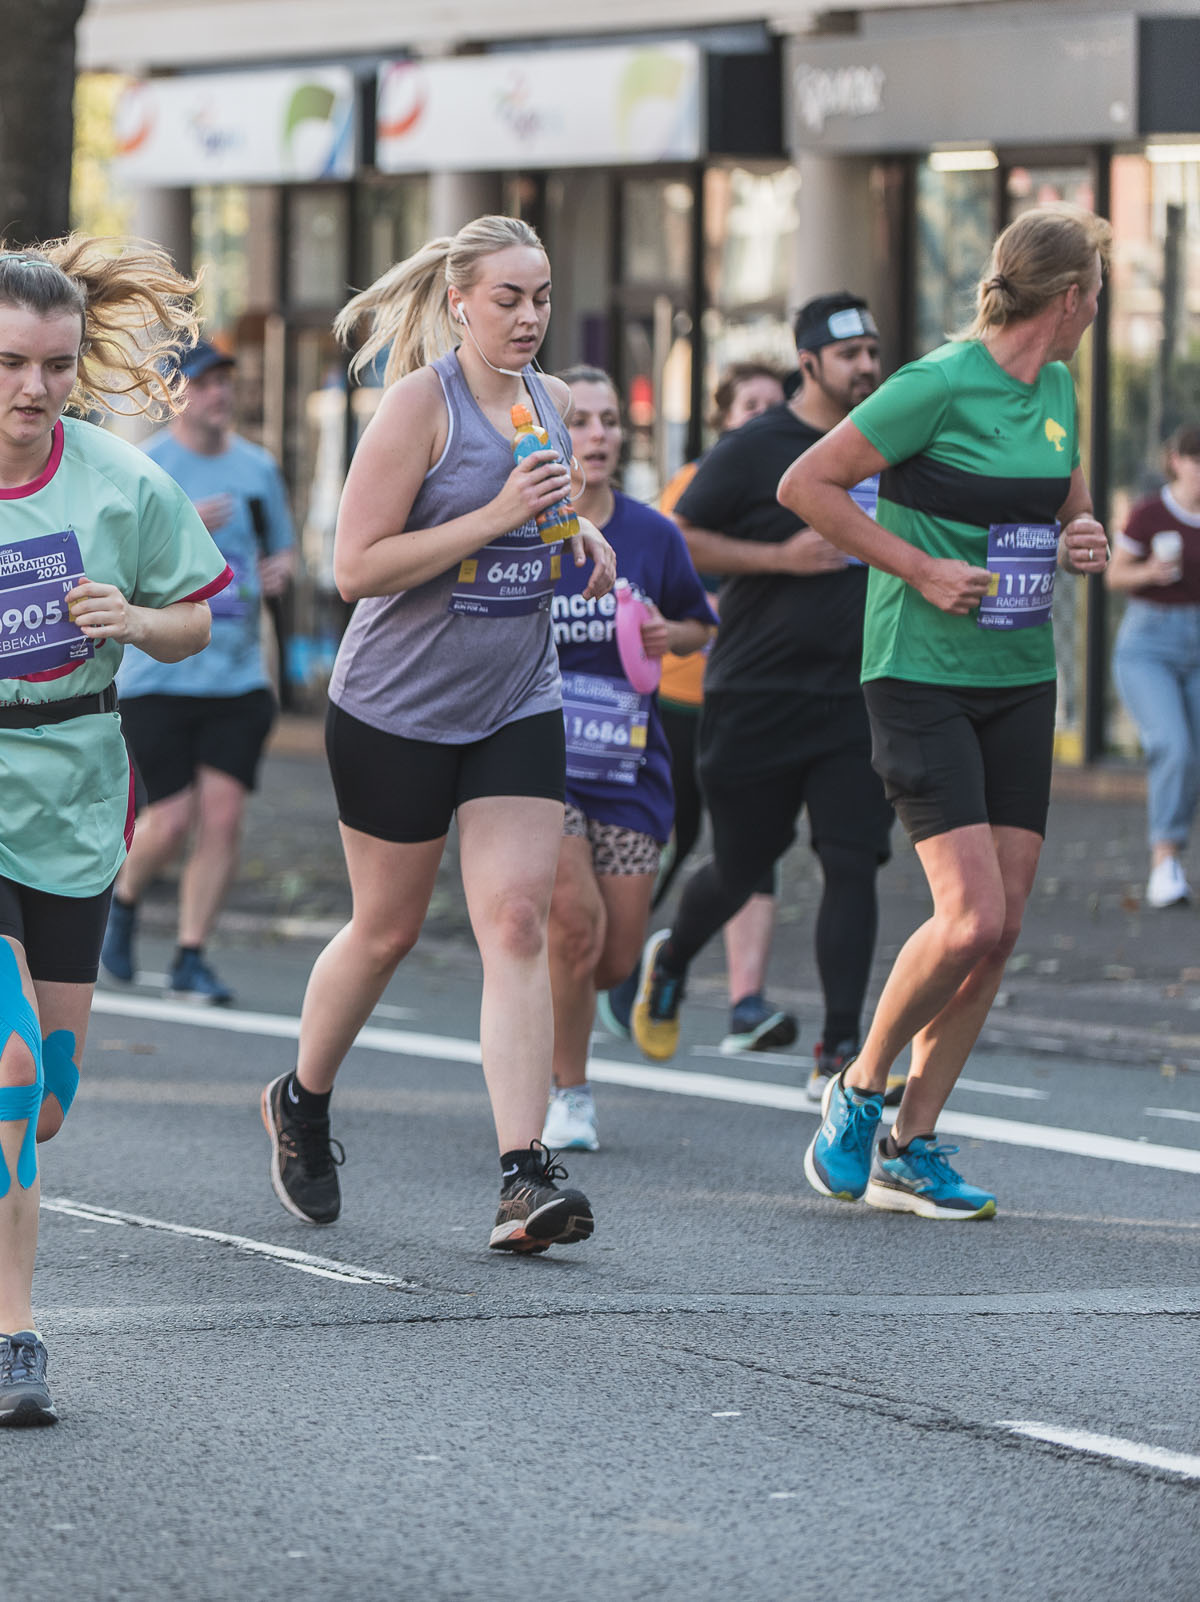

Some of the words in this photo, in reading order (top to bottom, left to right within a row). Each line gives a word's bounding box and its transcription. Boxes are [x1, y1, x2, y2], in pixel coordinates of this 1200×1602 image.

[0, 553, 65, 576] MARATHON
[36, 564, 68, 580] 2020
[487, 560, 543, 583] 6439
[499, 586, 527, 596] EMMA
[552, 592, 617, 619] ncre
[996, 596, 1030, 608] RACHEL
